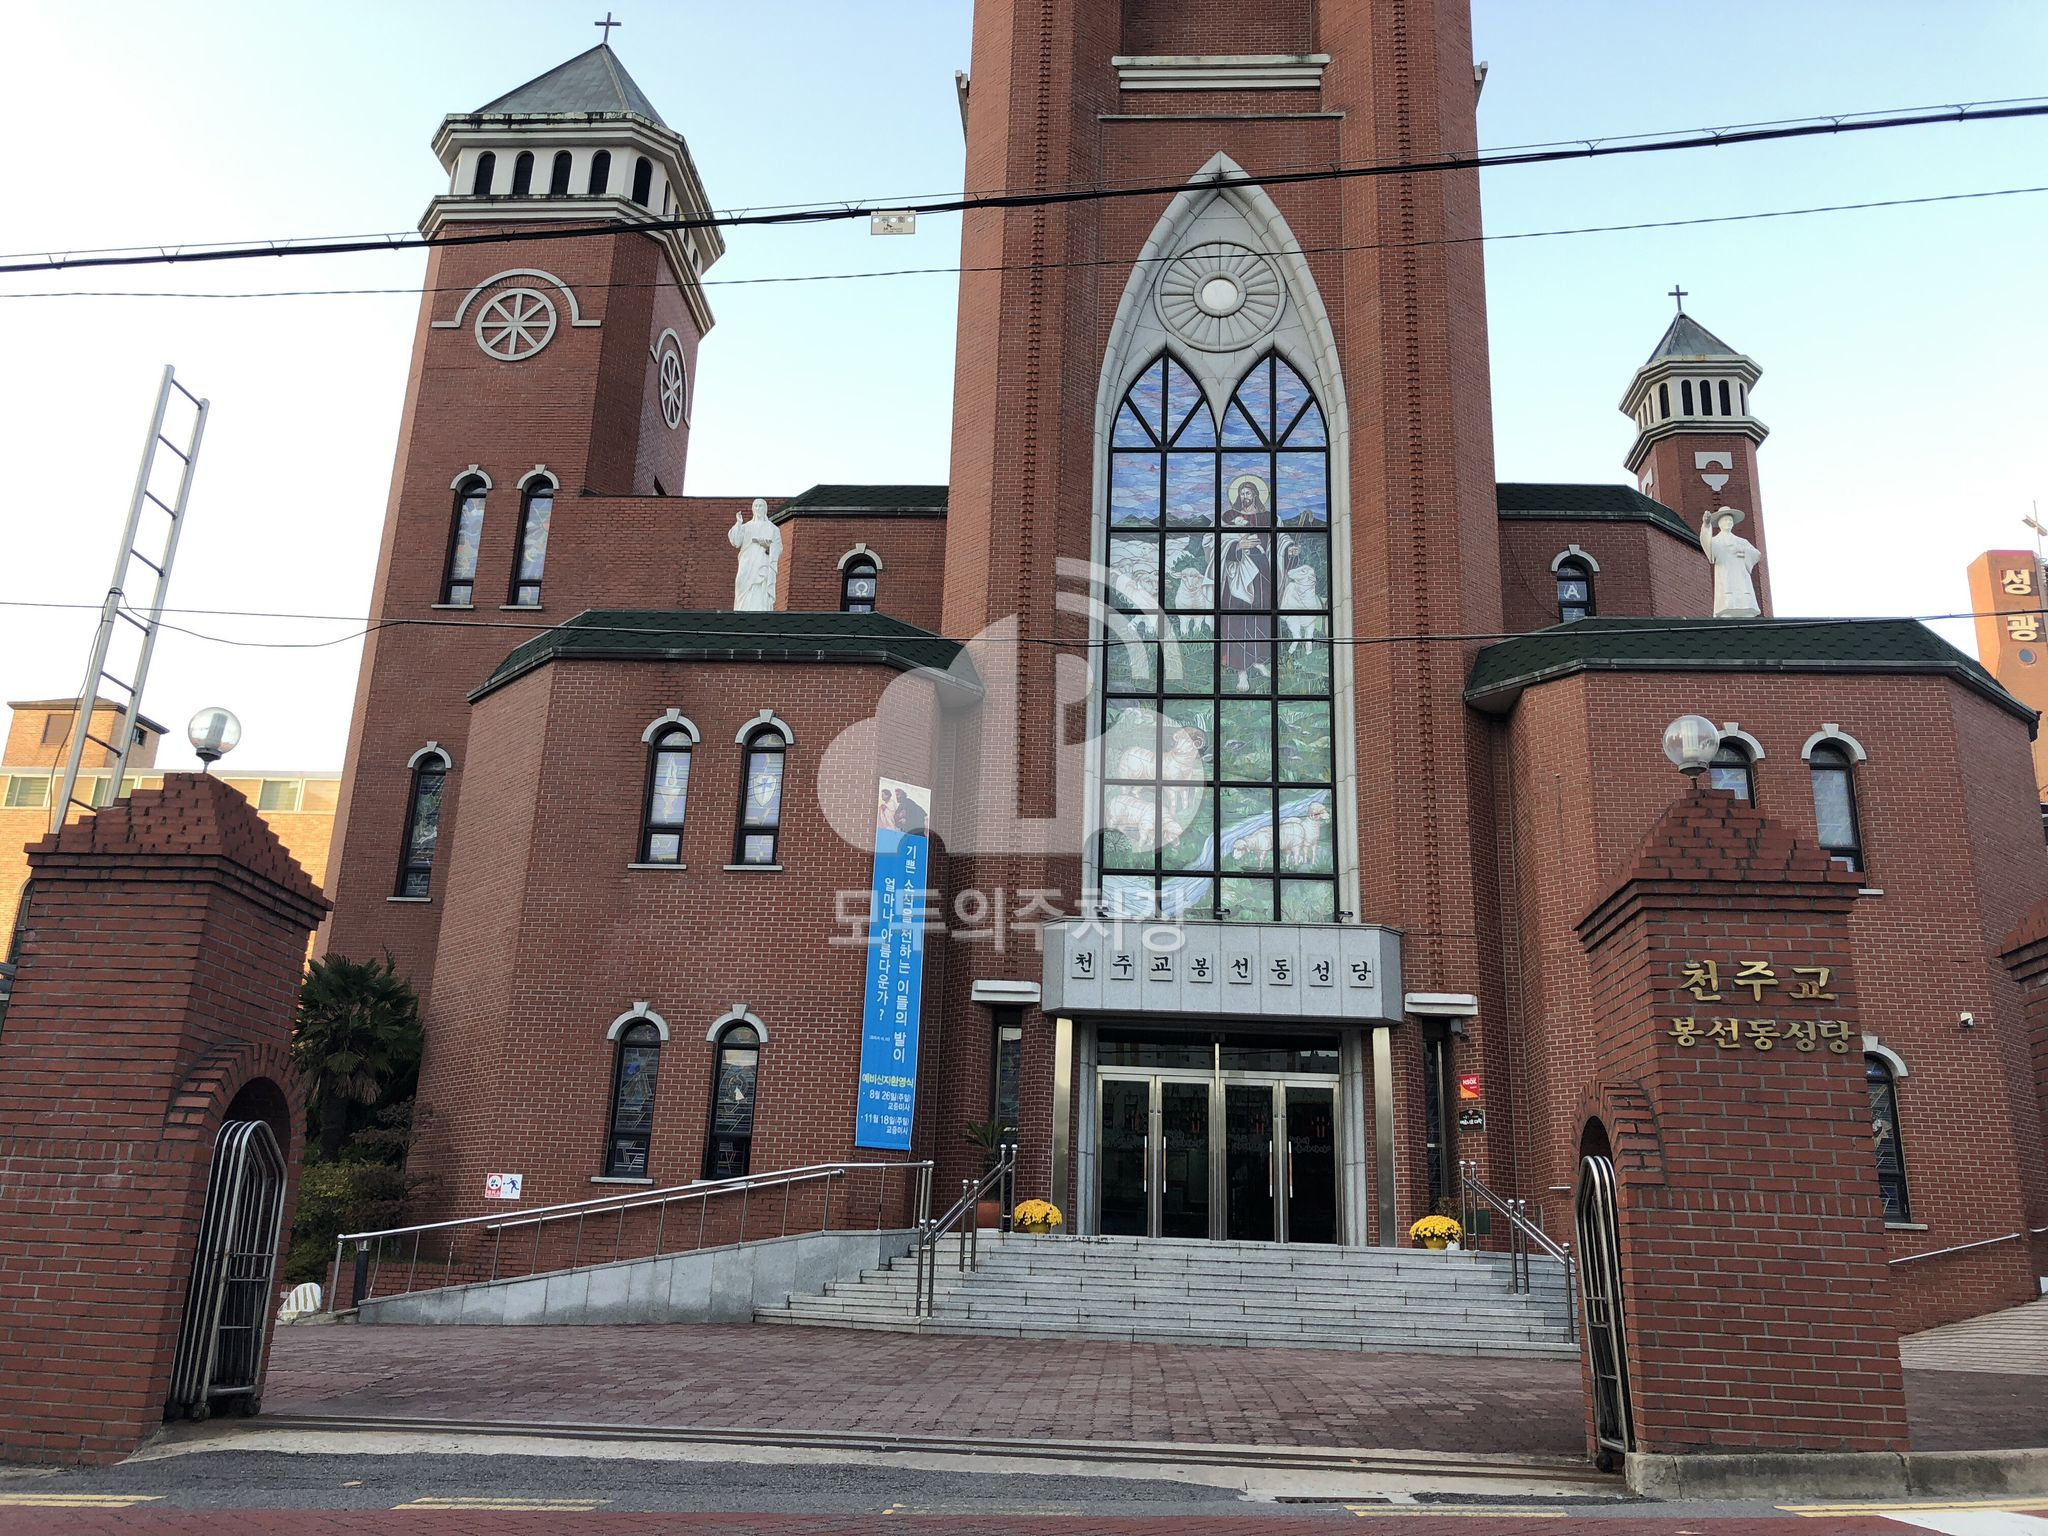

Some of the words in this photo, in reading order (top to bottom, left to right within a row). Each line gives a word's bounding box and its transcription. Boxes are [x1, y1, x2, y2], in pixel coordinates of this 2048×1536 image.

[2001, 569, 2039, 641] 성광
[905, 845, 917, 874] 기쁜
[882, 877, 895, 923] 얼마나
[902, 879, 915, 924] 소식을
[898, 929, 913, 975] 전하는
[1680, 959, 1836, 1002] 천주교
[895, 980, 909, 1027] 이들의
[893, 1031, 907, 1064] 발이
[1667, 1016, 1855, 1054] 봉선동성당
